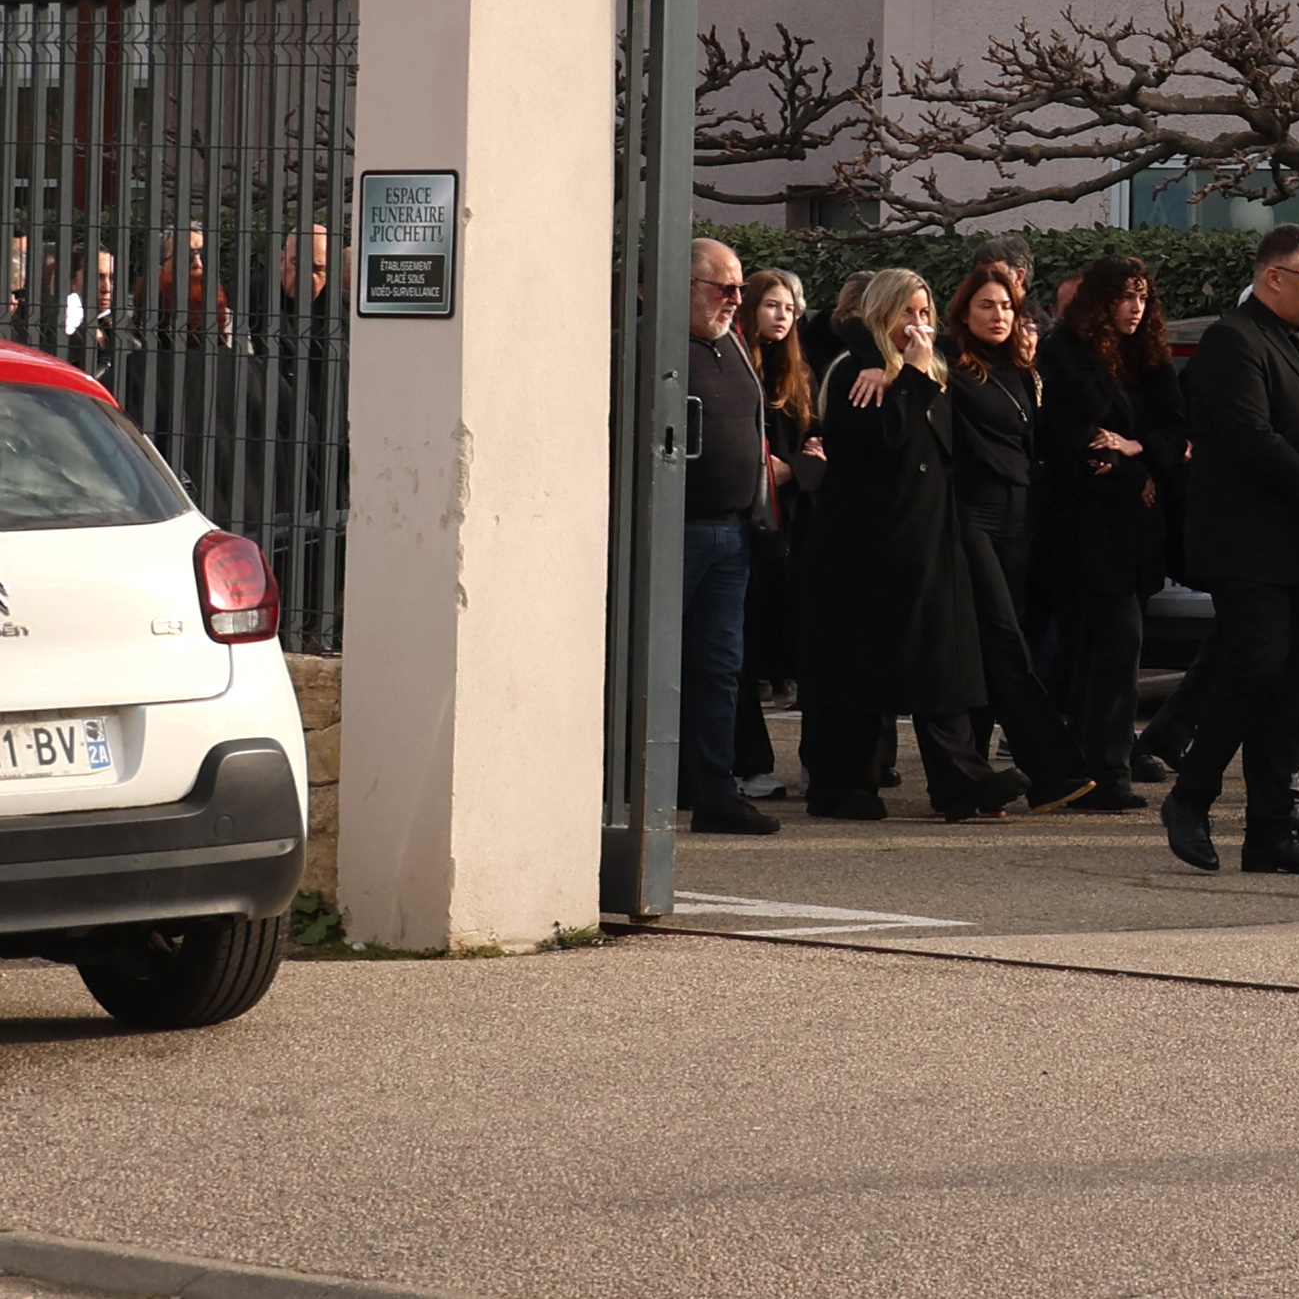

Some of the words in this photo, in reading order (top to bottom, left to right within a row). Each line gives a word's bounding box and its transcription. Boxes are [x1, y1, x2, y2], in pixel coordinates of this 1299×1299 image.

[385, 187, 432, 205] ESPACE
[371, 206, 445, 224] FUNERAIRE
[373, 225, 444, 243] PICCHETTI
[380, 258, 432, 272] ÉTABLISSEMENT
[386, 271, 407, 284] PLACÉ
[407, 274, 426, 285] SOUS
[371, 284, 440, 298] VIDÉO-SURVEILLANCE
[151, 617, 184, 636] C3
[0, 726, 75, 768] 1-BV
[88, 744, 109, 764] 2A
